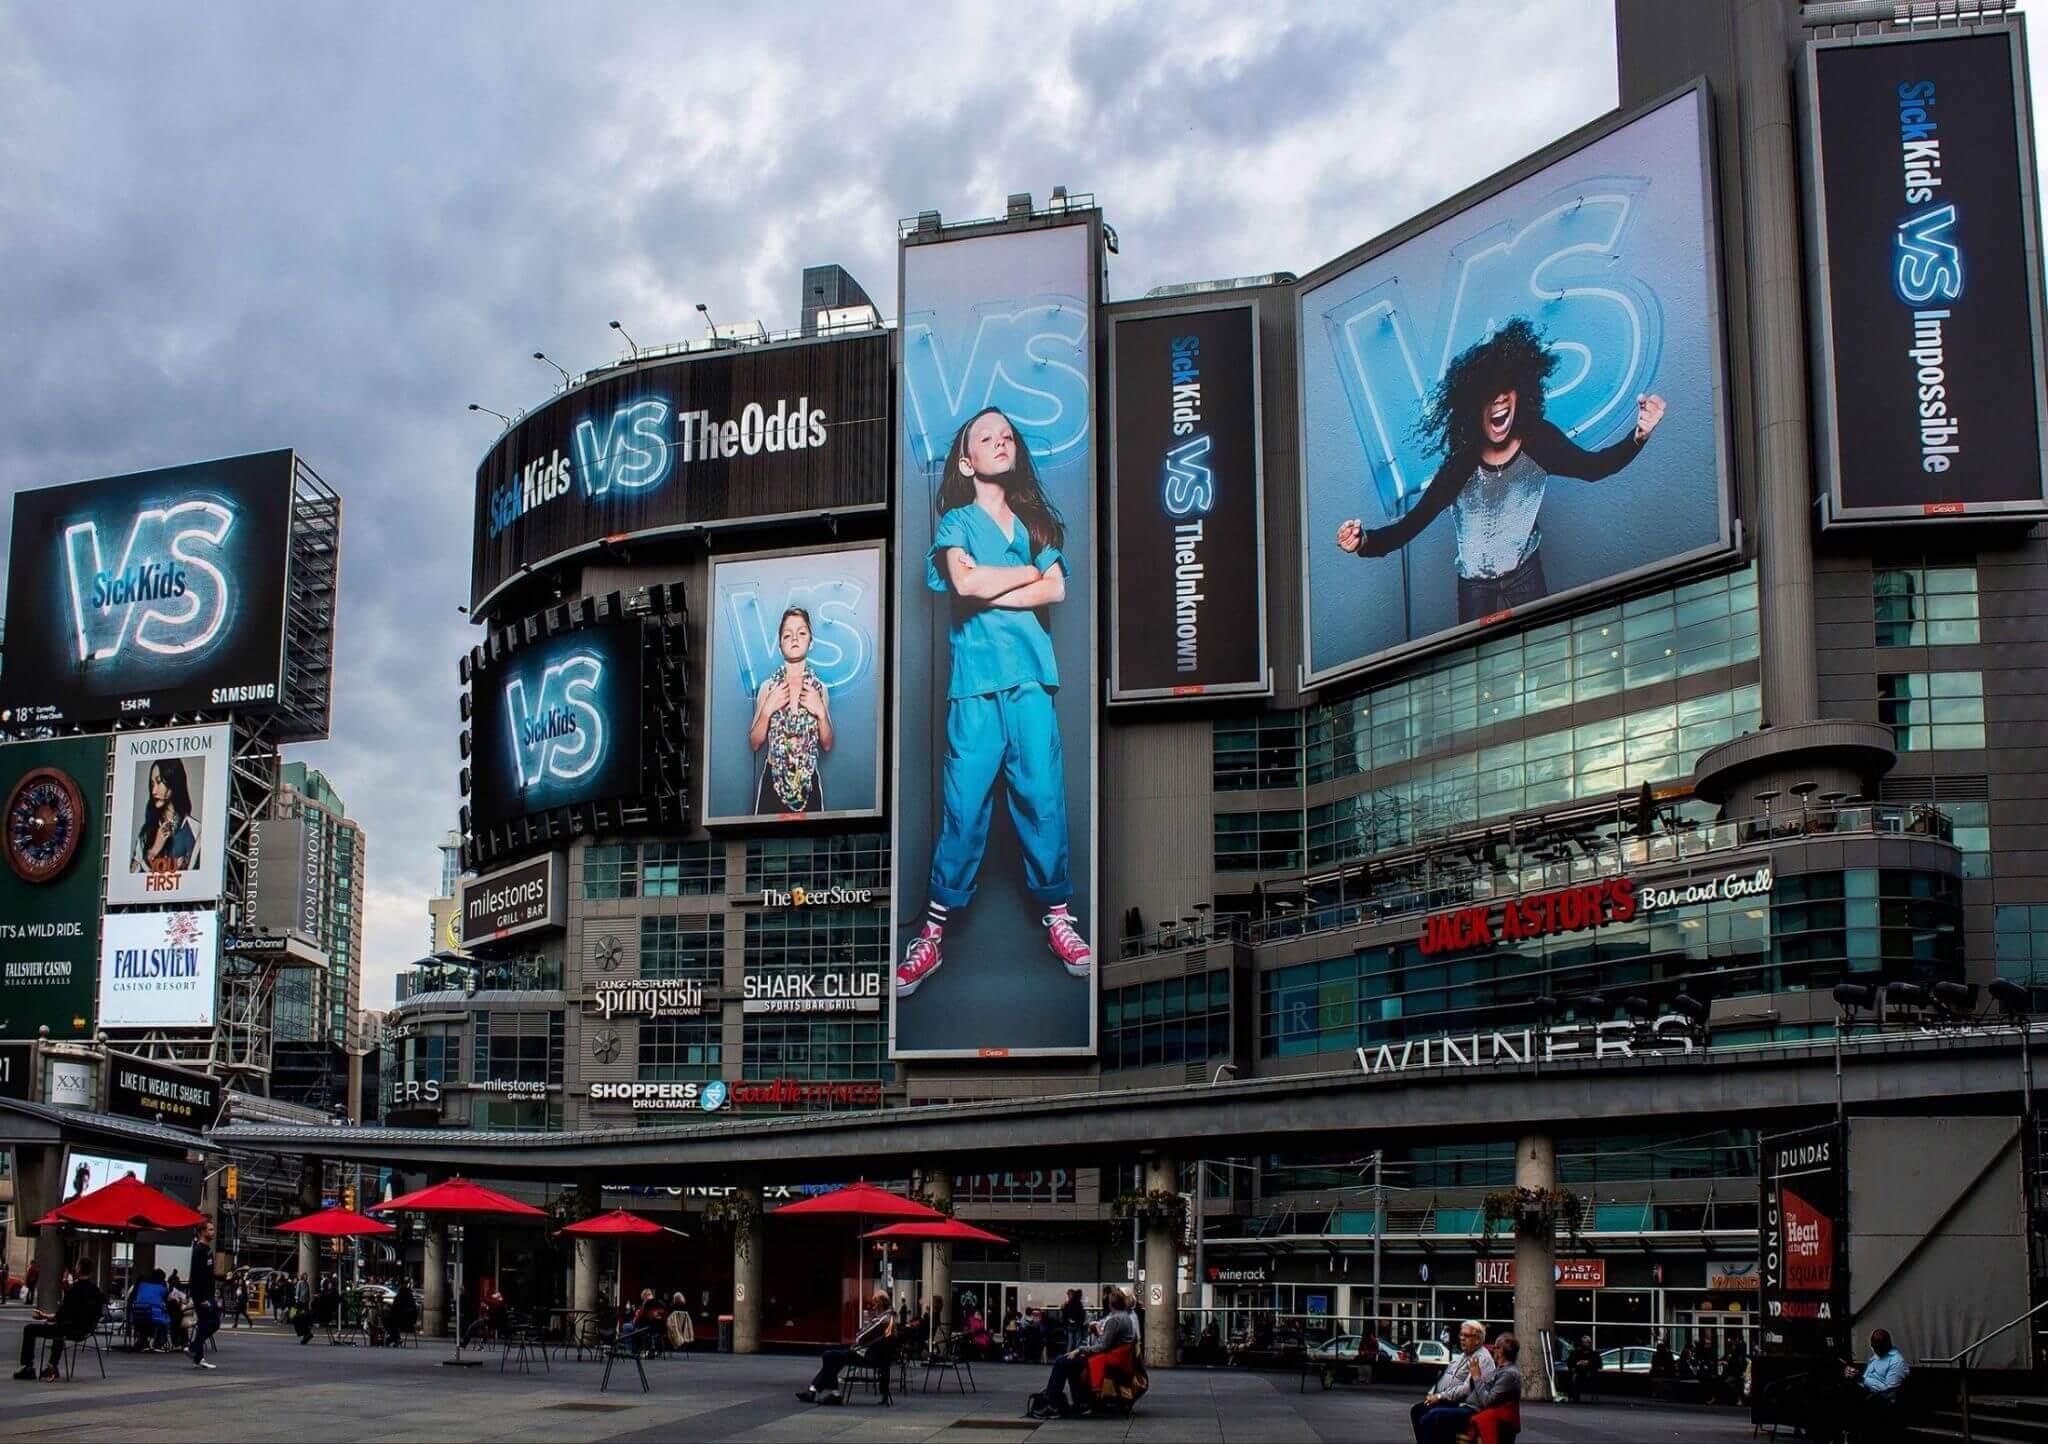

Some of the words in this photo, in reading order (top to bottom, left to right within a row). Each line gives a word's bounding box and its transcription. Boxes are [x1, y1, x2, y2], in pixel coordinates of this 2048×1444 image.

[1899, 79, 1943, 205] SickKids
[1897, 204, 1961, 301] VS
[1170, 335, 1202, 435] SickKids
[1908, 309, 1960, 474] Impossible
[490, 449, 571, 540] SickKids
[575, 400, 671, 497] VS
[678, 397, 829, 464] TheOdds
[1163, 435, 1214, 515] VS
[64, 500, 235, 662] VS
[92, 560, 187, 609] SickKids
[1174, 519, 1205, 673] TheUnknown
[211, 683, 275, 704] SAMSUNG
[505, 655, 604, 787] VS
[523, 708, 577, 747] SickKids
[130, 735, 212, 756] NORDSTROM
[145, 873, 182, 892] FIRST
[245, 820, 261, 928] NORDSTROM
[304, 826, 320, 935] NORDSTROM
[470, 878, 544, 919] milestones
[1418, 905, 1494, 956] JACK
[1502, 876, 1637, 943] ASTOR'S
[1642, 886, 1681, 911] Bar
[1686, 882, 1718, 902] and
[1723, 867, 1775, 899] Grill
[496, 911, 519, 928] GRILL
[527, 904, 544, 919] BAR
[0, 924, 17, 939] IT'S
[17, 924, 26, 939] A
[27, 922, 56, 937] WILD
[56, 921, 84, 937] RIDE.
[235, 938, 254, 949] Clear
[255, 937, 285, 949] Channel
[5, 961, 44, 977] FALLSVIEW
[44, 960, 72, 976] CASINO
[114, 947, 200, 979] FALLSVIEW
[4, 978, 43, 986] NIAGARA
[46, 977, 71, 985] FALLS
[113, 982, 151, 992] CASINO
[155, 981, 197, 991] RESORT
[595, 979, 628, 990] LOUNGE
[632, 978, 684, 990] RESTAURANT
[743, 973, 816, 998] SHARK
[823, 972, 881, 997] CLUB
[595, 989, 657, 1020] spring
[658, 978, 702, 1007] sushi
[764, 998, 801, 1010] SPORTS
[805, 998, 824, 1010] BAR
[829, 998, 856, 1010] GRILL
[1356, 1013, 1694, 1075] WINNERS
[56, 1074, 87, 1089] XXI
[120, 1071, 139, 1091] LIKE
[148, 1077, 170, 1097] WEAR
[179, 1085, 202, 1105] SHARE
[483, 1078, 546, 1092] milestones
[590, 1083, 698, 1099] SHOPPERS
[807, 1081, 880, 1104] FITNESS
[632, 1099, 665, 1109] DRUG
[665, 1099, 696, 1109] MART
[1781, 1142, 1830, 1168] DUNDAS
[1766, 1191, 1779, 1288] YONGE
[1787, 1220, 1820, 1242] Heart
[1801, 1241, 1820, 1256] CITY
[1218, 1267, 1241, 1280] wine
[1242, 1265, 1266, 1280] rack
[1476, 1262, 1511, 1284] BLAZE
[1712, 1276, 1760, 1289] WIND
